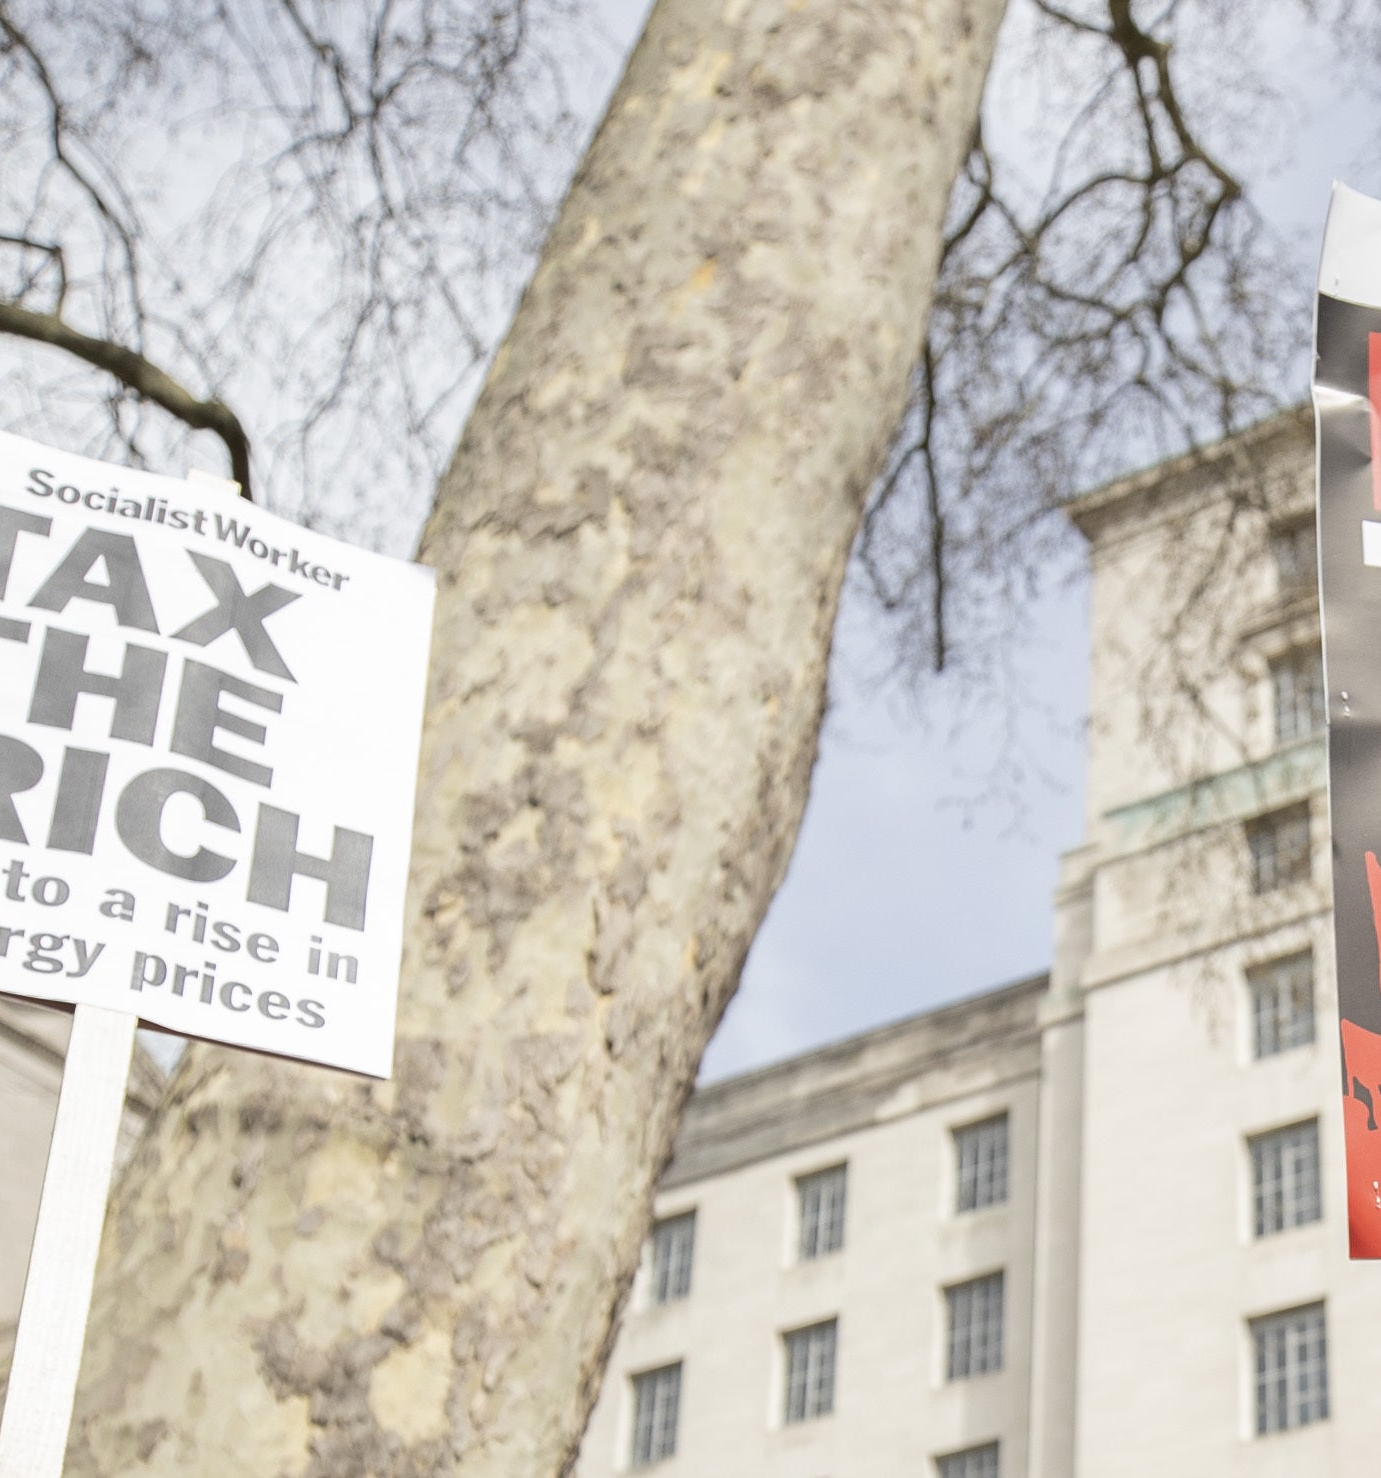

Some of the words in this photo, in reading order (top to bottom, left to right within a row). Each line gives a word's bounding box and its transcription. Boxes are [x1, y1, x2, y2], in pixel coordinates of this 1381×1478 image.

[25, 468, 208, 536] Socialist
[214, 512, 350, 592] Worker
[2, 860, 70, 906] to
[99, 888, 136, 922] a
[165, 901, 280, 964] rise
[308, 936, 359, 984] in
[130, 950, 327, 1029] prices
